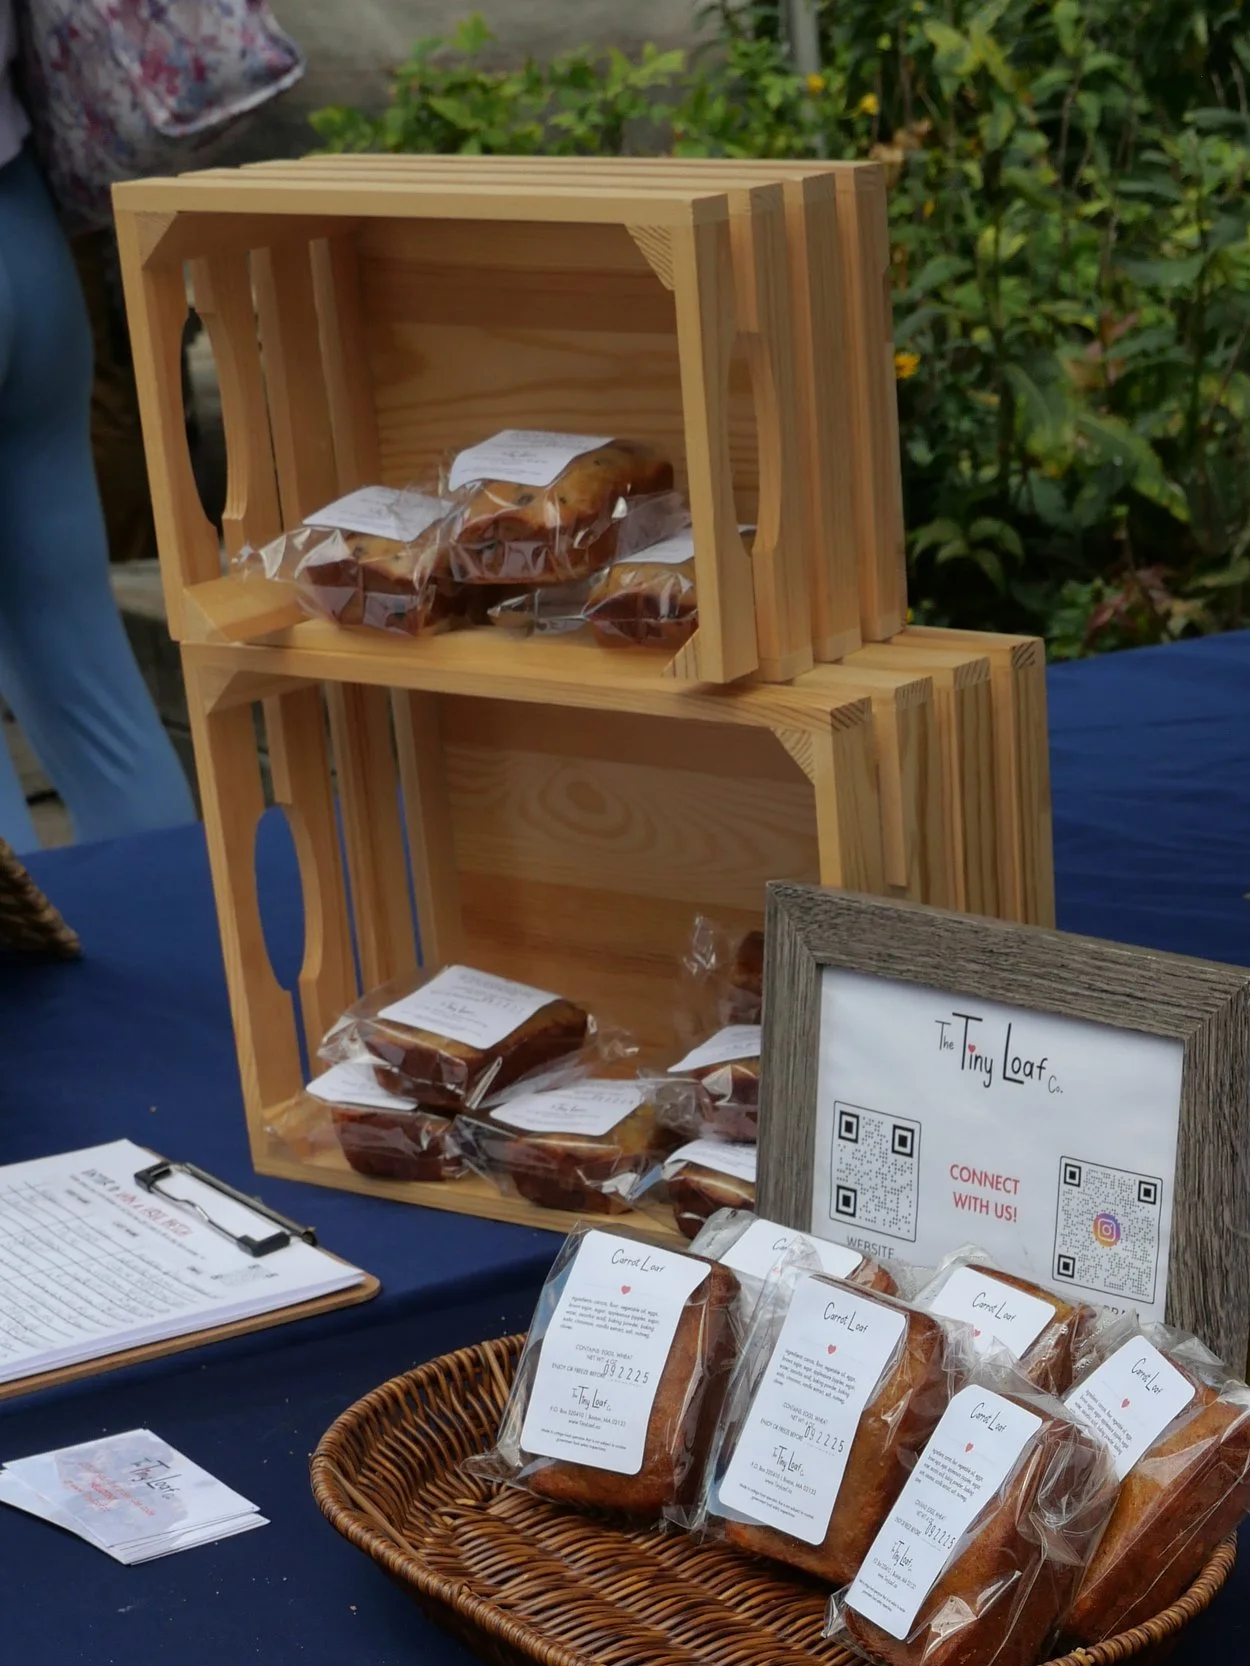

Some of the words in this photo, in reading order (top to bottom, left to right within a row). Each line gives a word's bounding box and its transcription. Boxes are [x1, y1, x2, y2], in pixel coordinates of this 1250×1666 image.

[935, 1020, 954, 1050] The
[952, 1012, 993, 1088] Tiny
[1002, 1022, 1048, 1084] Loaf
[1048, 1075, 1063, 1093] Co.
[950, 1164, 1020, 1195] CONNECT
[953, 1191, 989, 1215] WITH
[994, 1202, 1017, 1223] US!
[611, 1249, 640, 1268] Carrot
[640, 1255, 665, 1272] Loaf
[847, 1236, 894, 1259] WEBSITE
[824, 1302, 848, 1326] Carrot
[848, 1311, 868, 1333] Loaf
[972, 1291, 997, 1313] Carrot
[995, 1301, 1016, 1321] Loaf
[603, 1363, 649, 1384] 092225
[1131, 1357, 1151, 1382] Carrot
[1145, 1371, 1163, 1394] Loaf
[592, 1389, 608, 1409] Loaf
[970, 1402, 992, 1424] Carrot
[988, 1411, 1007, 1432] Loaf
[804, 1425, 845, 1453] 092225
[788, 1451, 802, 1472] Loaf
